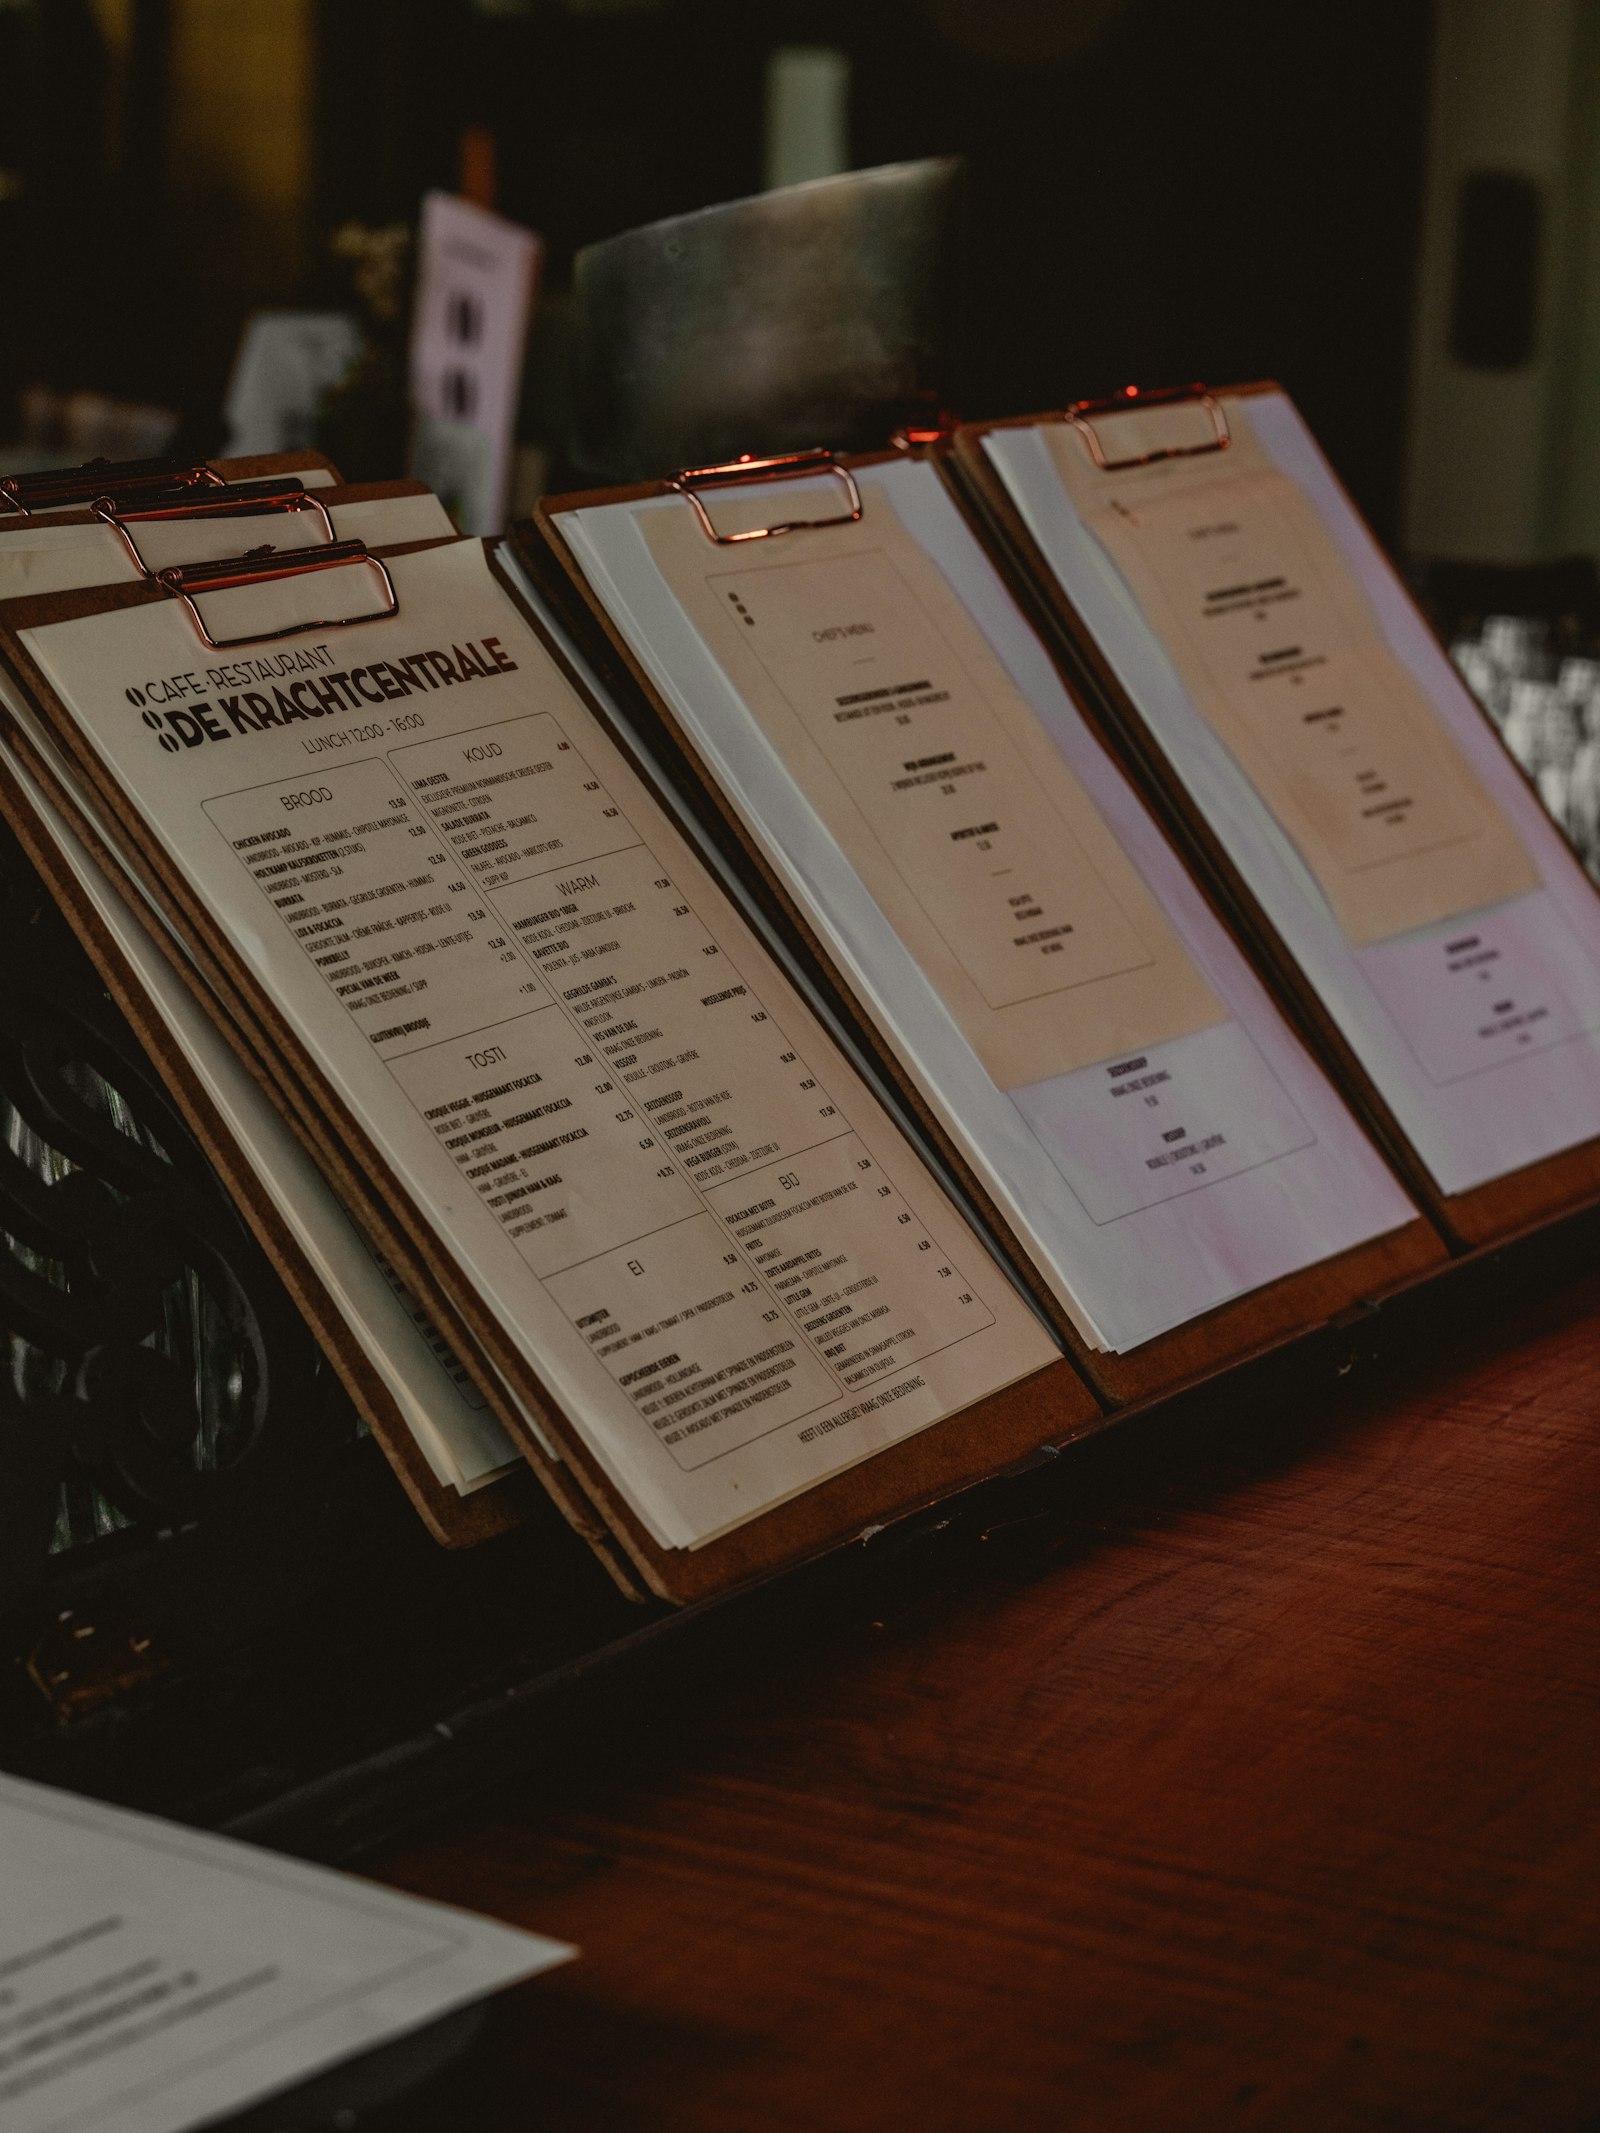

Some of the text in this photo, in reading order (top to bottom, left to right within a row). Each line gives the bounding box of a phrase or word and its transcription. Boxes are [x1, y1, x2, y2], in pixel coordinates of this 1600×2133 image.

[162, 636, 519, 748] DE KRACHTCENTRALE
[300, 713, 425, 754] LUNCH 12:00 16:00
[461, 742, 503, 763] KOUD
[410, 778, 429, 790] LIMA
[426, 772, 450, 786] OESTER
[279, 786, 333, 811] BROOD
[231, 797, 407, 850] CHICKEN AVOCADO 13.50
[440, 817, 465, 832] SALADE
[461, 810, 491, 825] BURRATA
[252, 862, 288, 879] HOLTKAMP
[286, 849, 340, 870] KALFSKROKETTEN
[342, 842, 366, 855] STUKS)
[407, 825, 426, 837] 12.50
[460, 846, 483, 859] GREEN
[479, 838, 508, 853] GODDESS
[273, 853, 446, 909] BURRATA 12.50
[555, 873, 600, 896] WARM
[293, 926, 310, 938] LOX
[311, 916, 344, 933] FOCACCIA
[511, 912, 551, 931] HAMBURGER
[547, 908, 561, 919] BIO
[314, 909, 486, 967] PORKBELLY 13.50
[531, 943, 559, 959] BAVETTE
[555, 940, 570, 951] BIO
[335, 937, 506, 997] SPECIAL VAN DE WEEK 12.50
[562, 983, 593, 1000] GEGRILDE
[592, 1031, 606, 1042] VIS
[601, 1026, 618, 1038] VAN
[614, 1023, 626, 1034] DE
[622, 1019, 638, 1031] DAG
[464, 1045, 507, 1069] TOSTI
[612, 1054, 638, 1069] VISSOEP
[643, 1089, 683, 1112] SEIZOENSSOEP
[663, 1115, 712, 1140] SEIZOENSRAVIOLI
[683, 1154, 702, 1168] VEGA
[698, 1146, 724, 1162] BURGER
[720, 1140, 740, 1155] (SOYA)
[777, 1171, 800, 1190] BIJ
[724, 1209, 751, 1225] FOCACCIA
[747, 1204, 761, 1216] MET
[757, 1198, 776, 1211] BOTER
[744, 1238, 763, 1251] FRITES
[626, 1259, 645, 1276] EI
[763, 1265, 782, 1279] ZOETE
[778, 1254, 808, 1272] AARDAPPEL
[803, 1248, 822, 1261] FRITES
[783, 1292, 801, 1305] LITTLE
[798, 1287, 812, 1298] GEM
[803, 1315, 828, 1332] SEIZOENS
[825, 1304, 853, 1322] GROENTEN
[796, 1375, 926, 1444] HEEFT U EEN ALLERGIE? VRAAG ONZE BEDIENING
